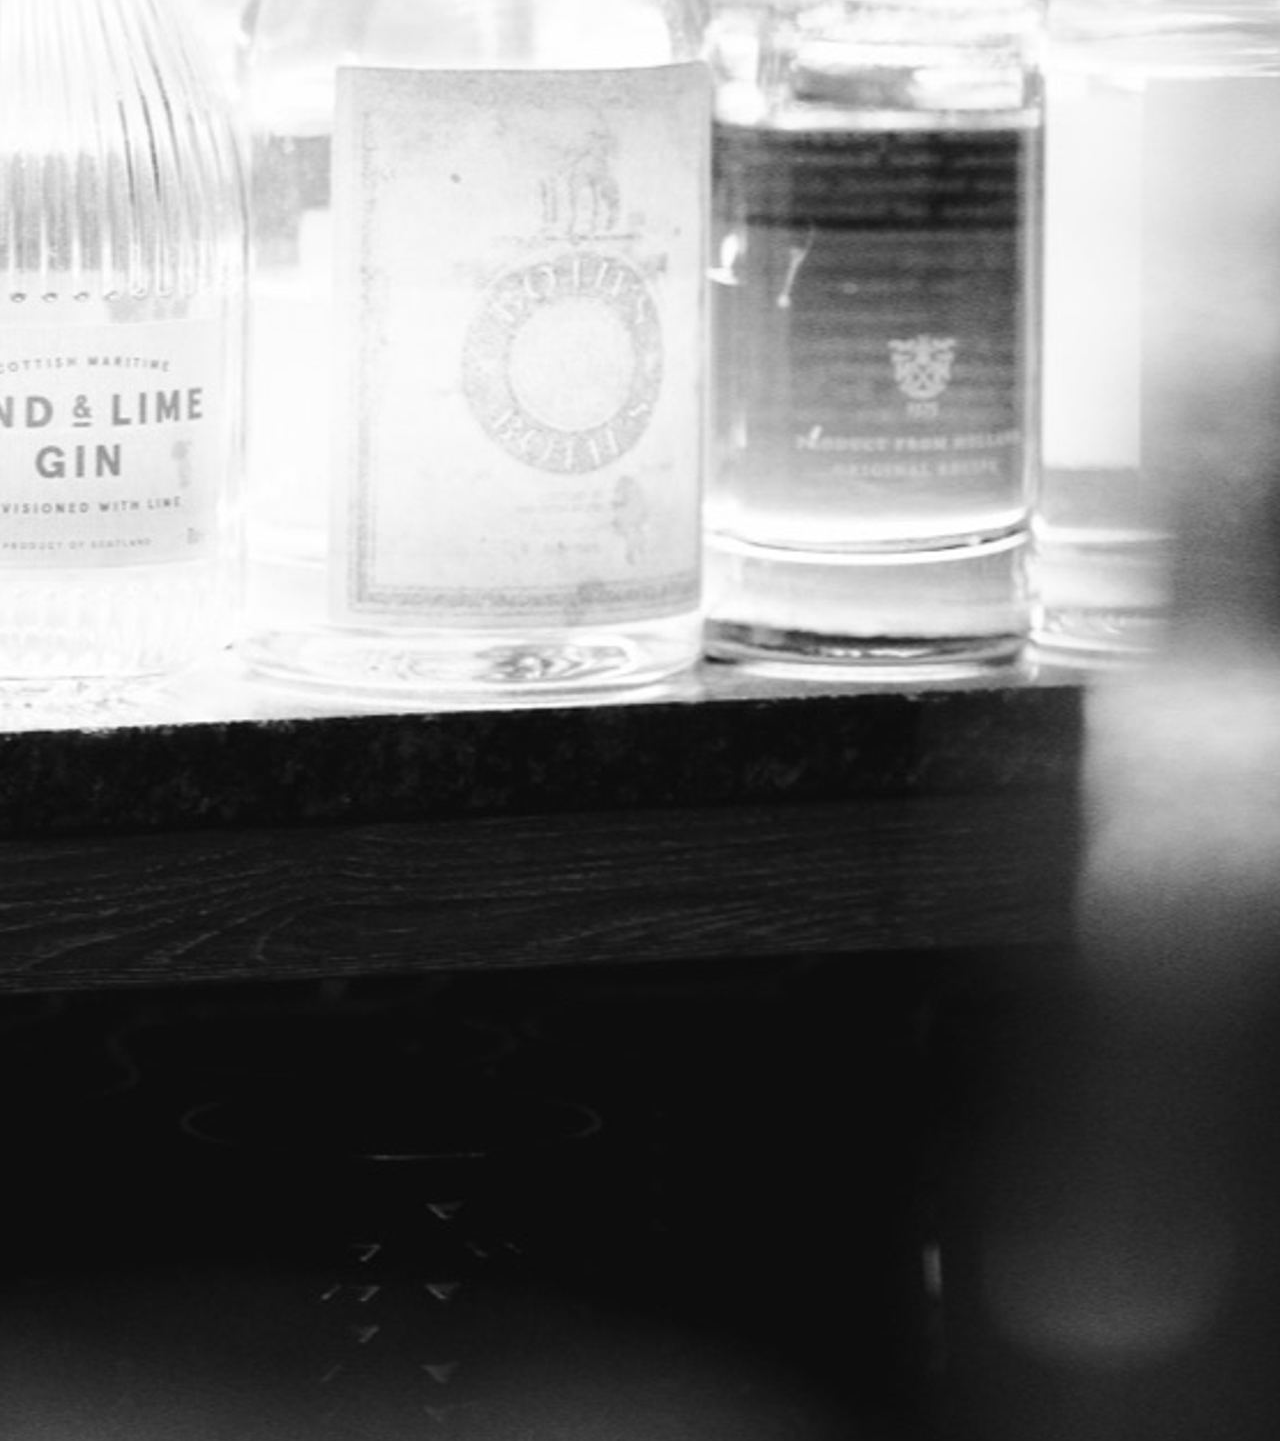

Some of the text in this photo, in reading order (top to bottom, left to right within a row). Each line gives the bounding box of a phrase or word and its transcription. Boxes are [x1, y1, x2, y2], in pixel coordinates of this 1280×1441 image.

[72, 394, 93, 423] &
[111, 388, 204, 426] LIME
[35, 443, 122, 479] GIN
[98, 500, 141, 514] WITH
